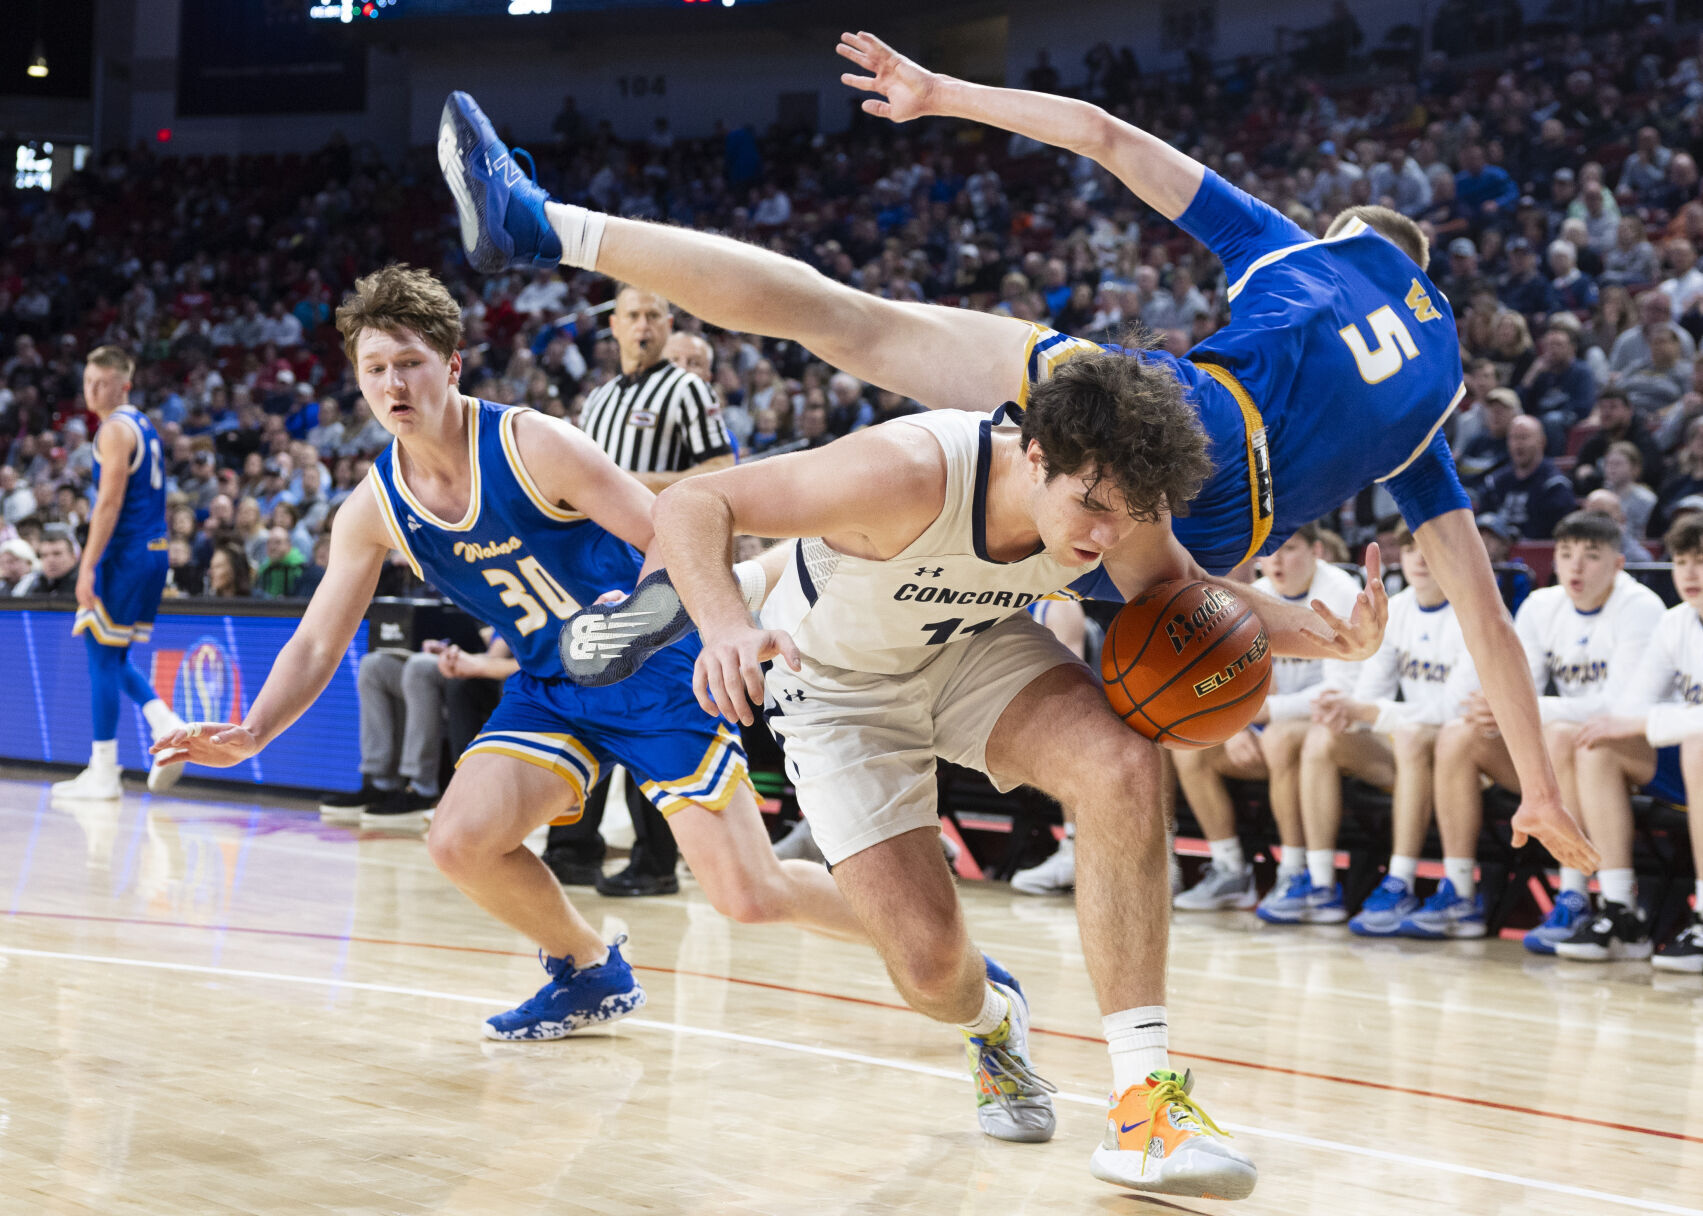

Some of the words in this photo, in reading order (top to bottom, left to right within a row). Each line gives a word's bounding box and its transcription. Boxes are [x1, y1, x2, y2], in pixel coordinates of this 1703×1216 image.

[1404, 277, 1443, 323] W
[1338, 304, 1421, 385] 5
[481, 555, 583, 637] 30
[1165, 588, 1238, 655] Baden
[1193, 644, 1258, 698] ELITE
